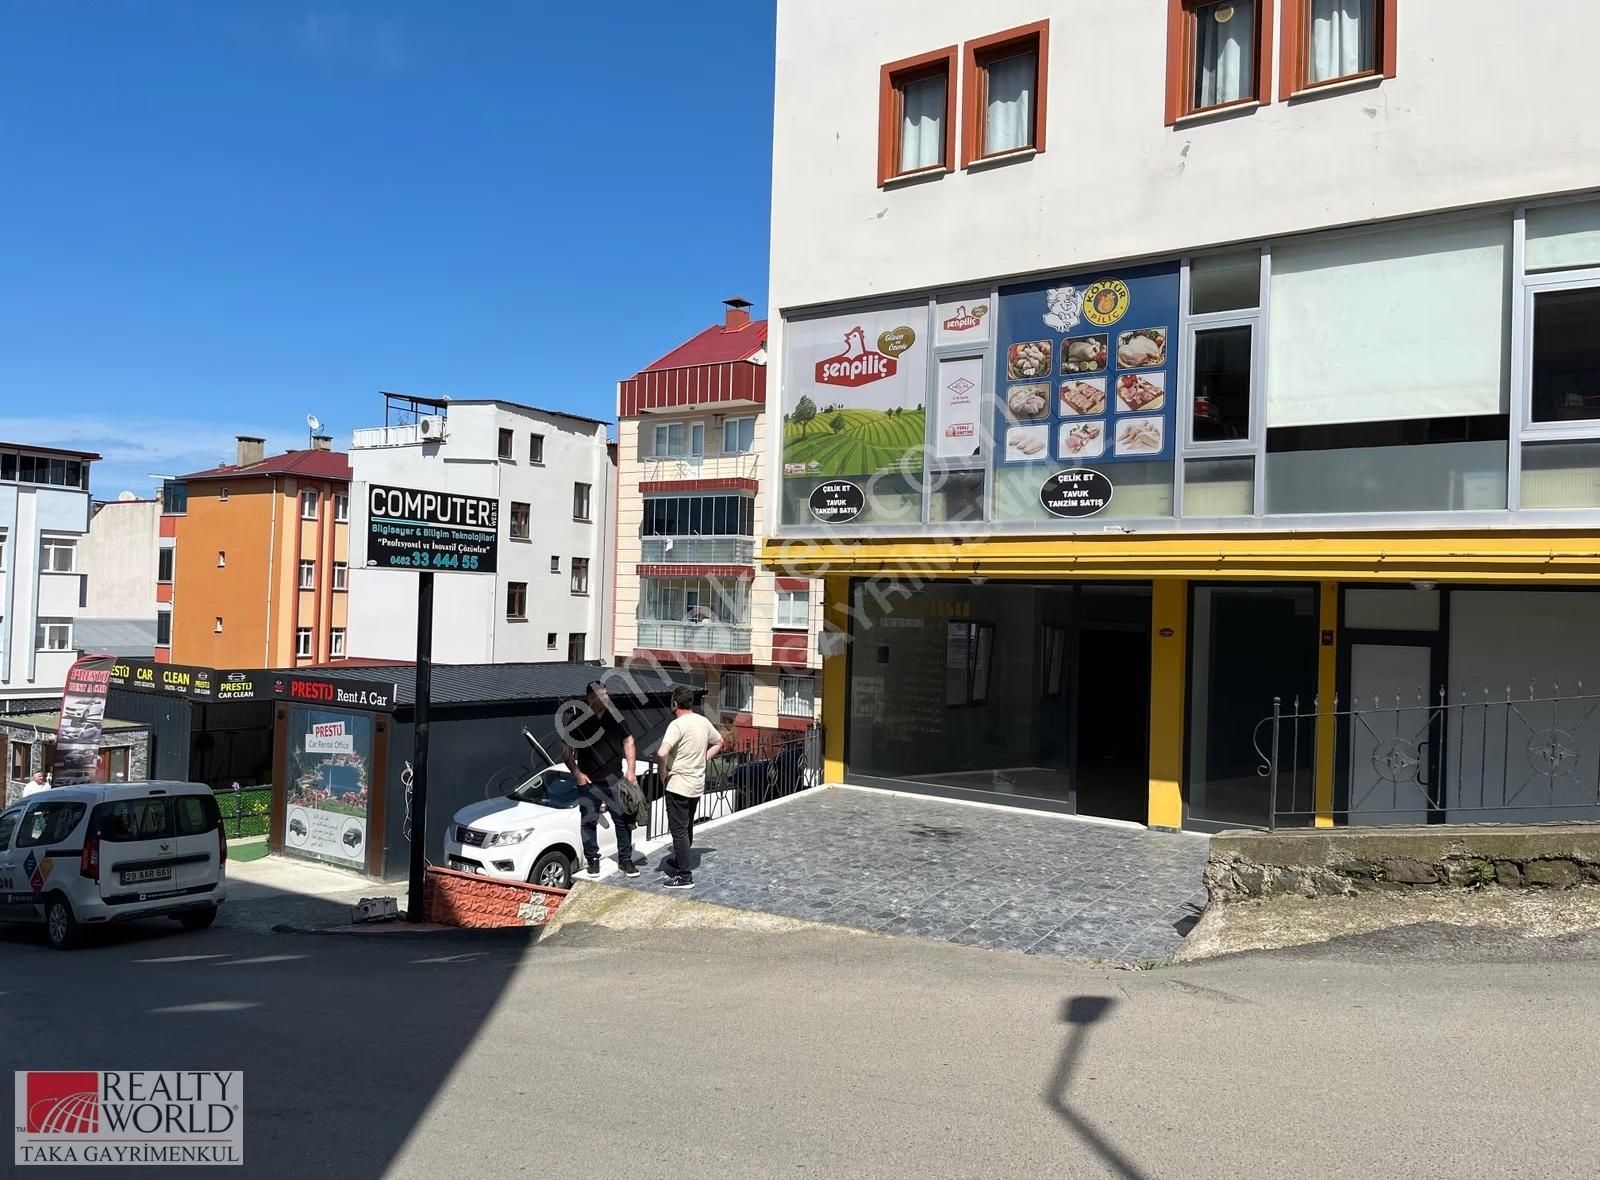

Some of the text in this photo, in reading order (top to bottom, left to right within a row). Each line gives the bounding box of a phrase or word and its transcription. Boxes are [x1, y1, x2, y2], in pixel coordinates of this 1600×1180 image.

[822, 355, 888, 381] şenpiliç
[1058, 473, 1082, 484] ÇELİK
[822, 485, 841, 493] ÇELİK
[1062, 490, 1089, 498] TAVUK
[371, 488, 490, 526] COMPUTER
[1047, 499, 1104, 507] TANZİM SATIŞ
[839, 507, 857, 515] SATIŞ
[372, 524, 415, 537] Bilgisayar
[416, 528, 422, 536] &
[451, 531, 495, 542] Teknolojileri
[412, 551, 430, 566] 33
[432, 553, 459, 568] 444
[461, 555, 479, 569] 55
[136, 668, 153, 680] CAR
[163, 670, 190, 685] CLEAN
[336, 688, 358, 703] Rent
[359, 691, 368, 704] A
[369, 691, 388, 706] Car
[309, 740, 349, 750] Car Rental Office
[126, 872, 137, 881] 29
